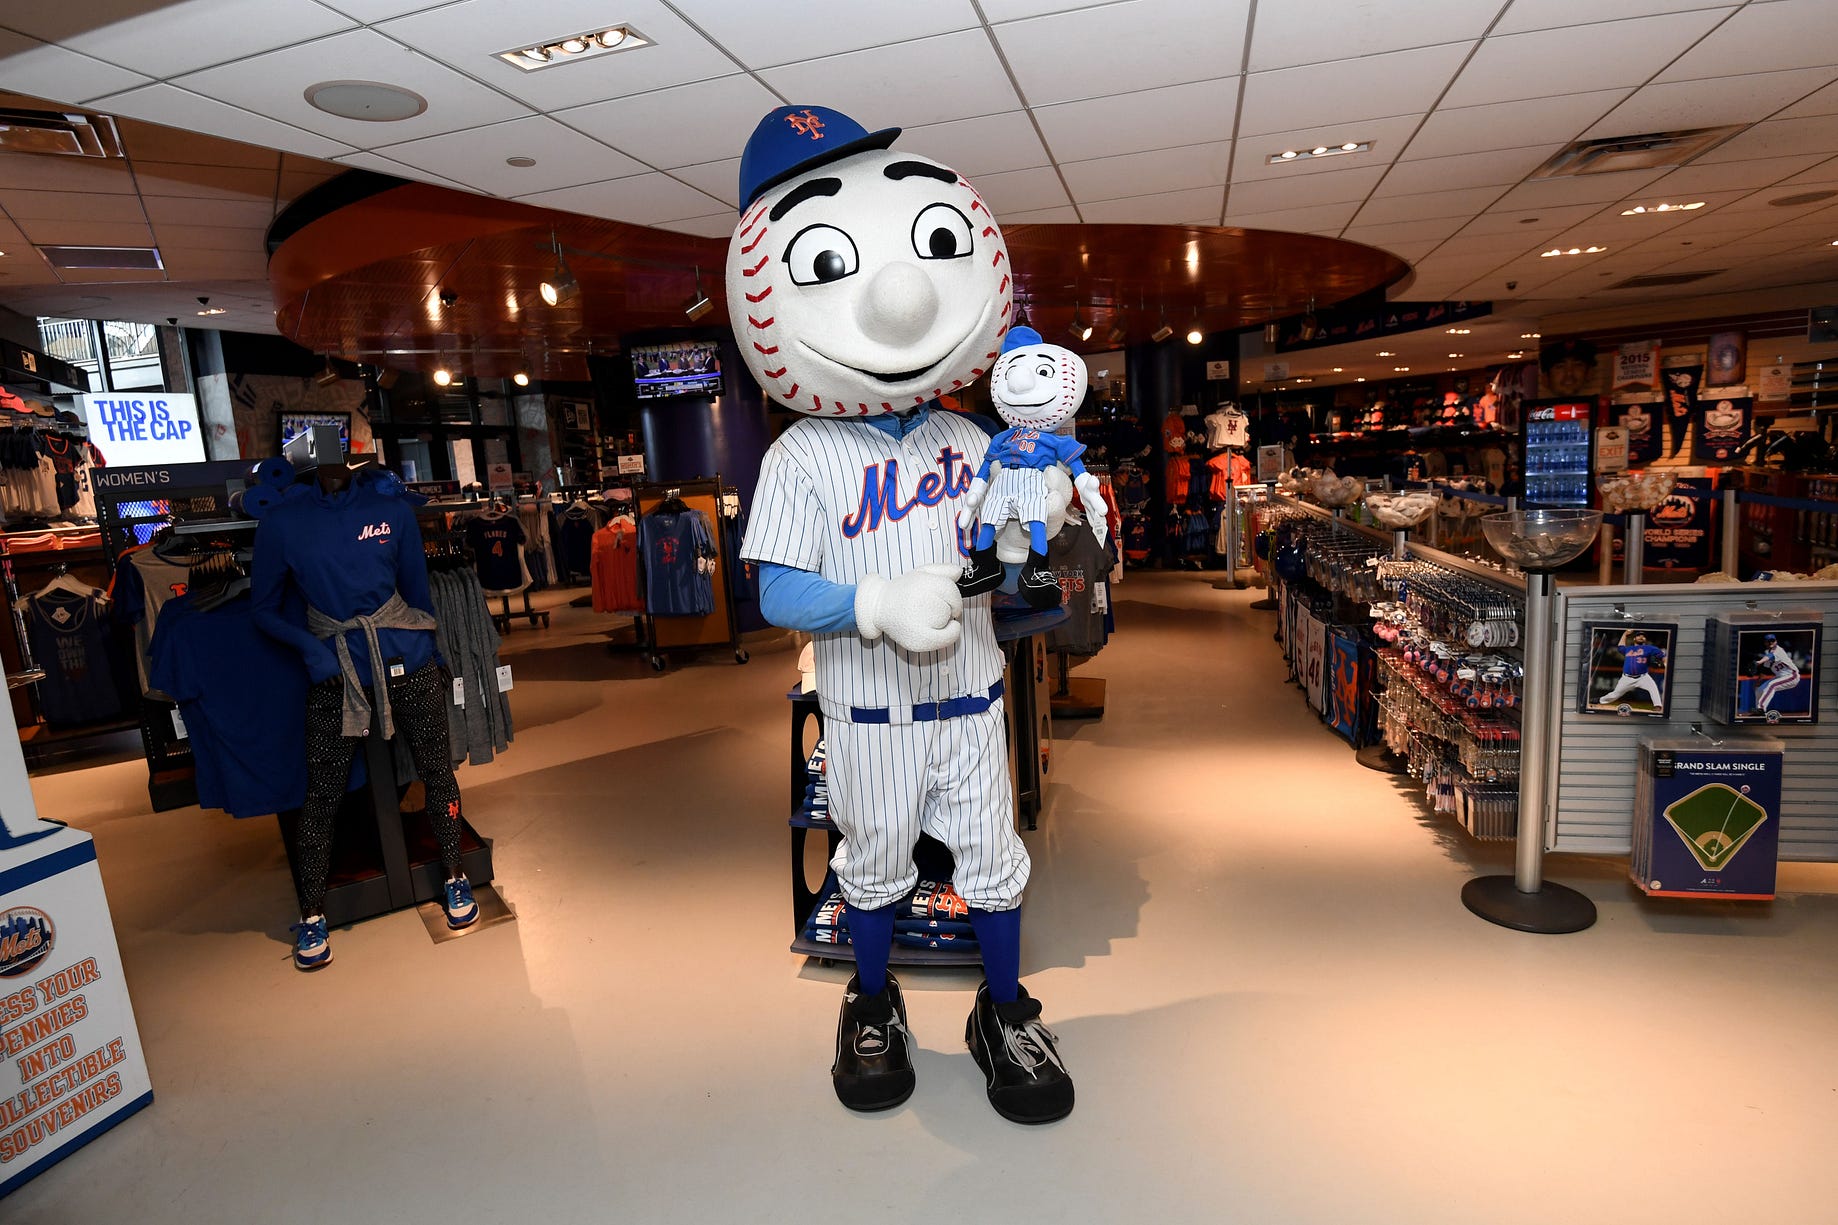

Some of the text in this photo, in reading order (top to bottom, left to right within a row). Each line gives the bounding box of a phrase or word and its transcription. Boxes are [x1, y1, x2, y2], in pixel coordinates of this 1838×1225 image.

[1620, 353, 1650, 365] 2015
[94, 400, 170, 424] THIS IS
[104, 420, 192, 441] THE CAP
[1019, 440, 1036, 453] 00
[1599, 447, 1624, 457] EXIT
[96, 470, 170, 487] WOMEN'S
[842, 446, 975, 538] Mets
[357, 521, 391, 541] Mets
[1644, 535, 1698, 543] CHAMPIONS
[491, 540, 503, 558] 4
[1058, 577, 1085, 592] ETS
[1308, 657, 1320, 688] 48
[1674, 762, 1704, 770] RAND
[1732, 763, 1765, 771] SINGLE
[816, 893, 843, 925] METS
[0, 927, 42, 961] Mets
[0, 956, 101, 1026] ESS YOUR
[17, 1033, 76, 1084] INTO
[0, 1036, 126, 1130] OLLECTIBLE
[0, 1071, 122, 1163] SOUVENIRS
